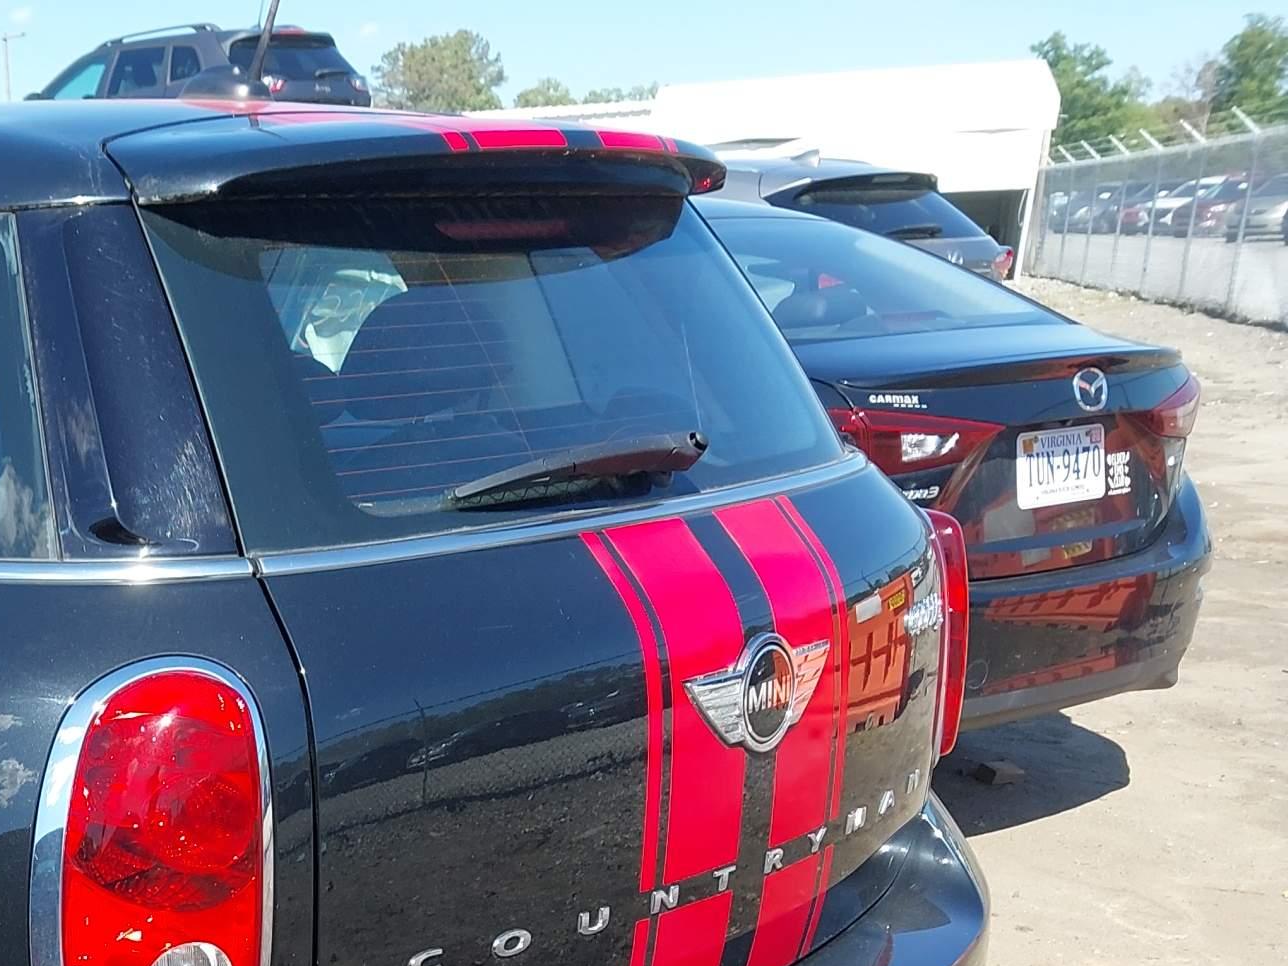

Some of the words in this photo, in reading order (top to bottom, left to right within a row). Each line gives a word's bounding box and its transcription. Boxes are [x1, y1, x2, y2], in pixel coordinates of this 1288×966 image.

[1039, 433, 1083, 449] VIRGINIA
[1025, 445, 1102, 488] TUN-9470
[748, 675, 792, 714] MINI
